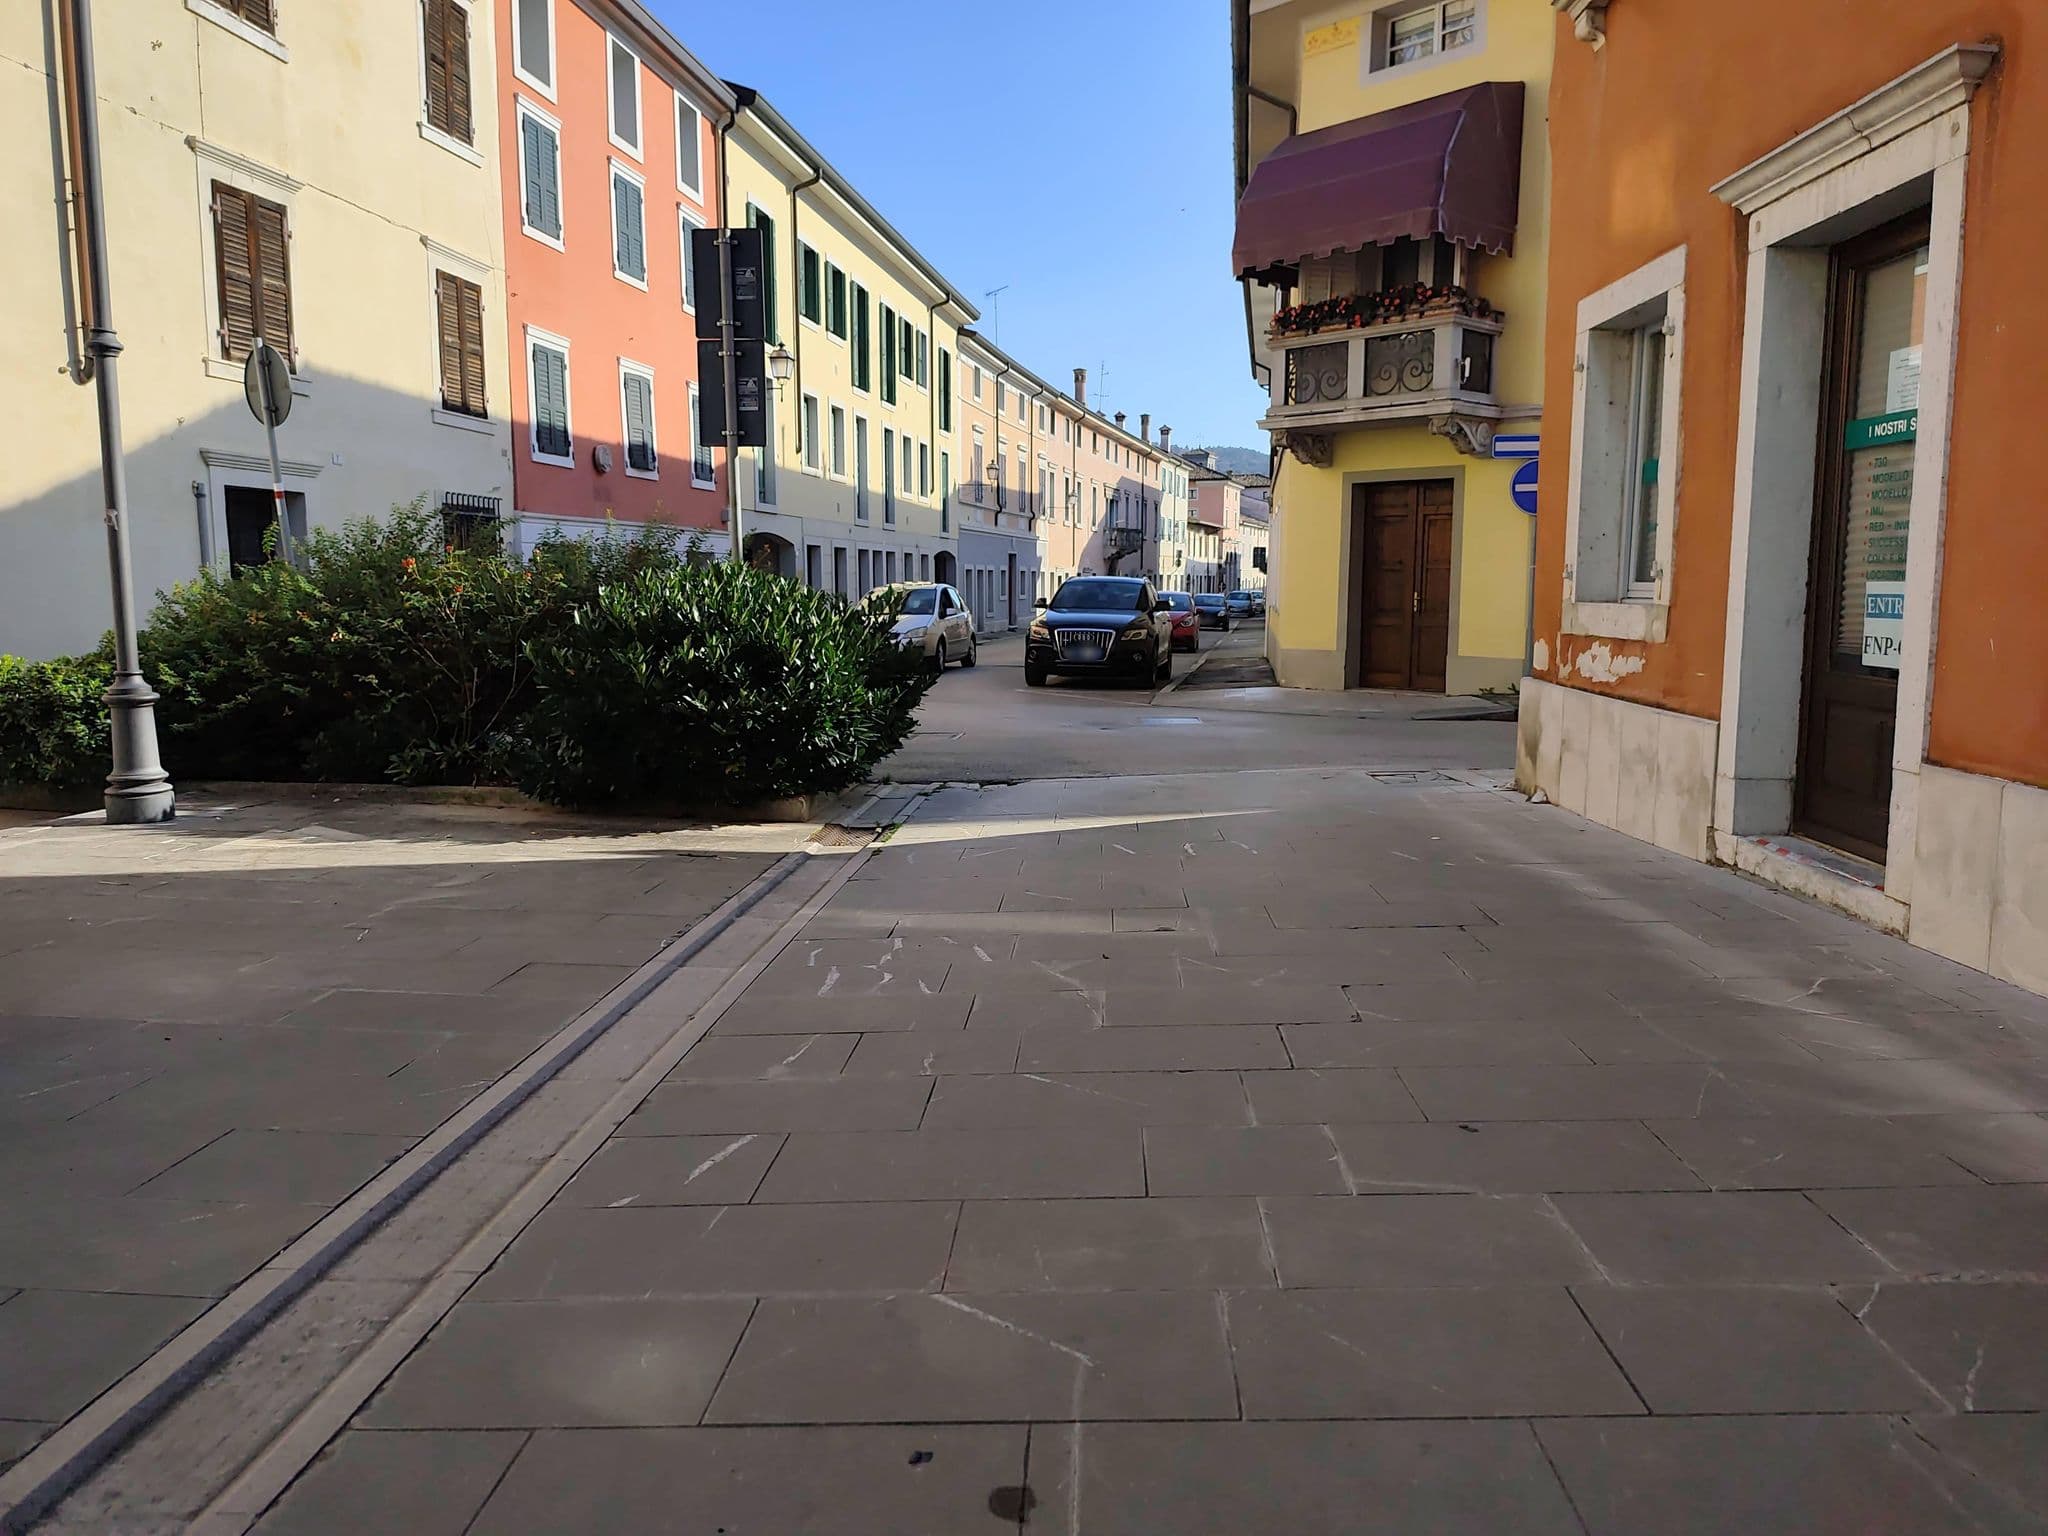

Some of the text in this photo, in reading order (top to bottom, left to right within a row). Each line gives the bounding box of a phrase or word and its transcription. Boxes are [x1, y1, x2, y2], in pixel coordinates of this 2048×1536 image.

[1868, 425, 1873, 439] I
[1874, 419, 1907, 438] NOSTRI
[1872, 470, 1909, 483] MODELLO
[1871, 488, 1908, 500] MODELLO
[1869, 521, 1885, 532] RED
